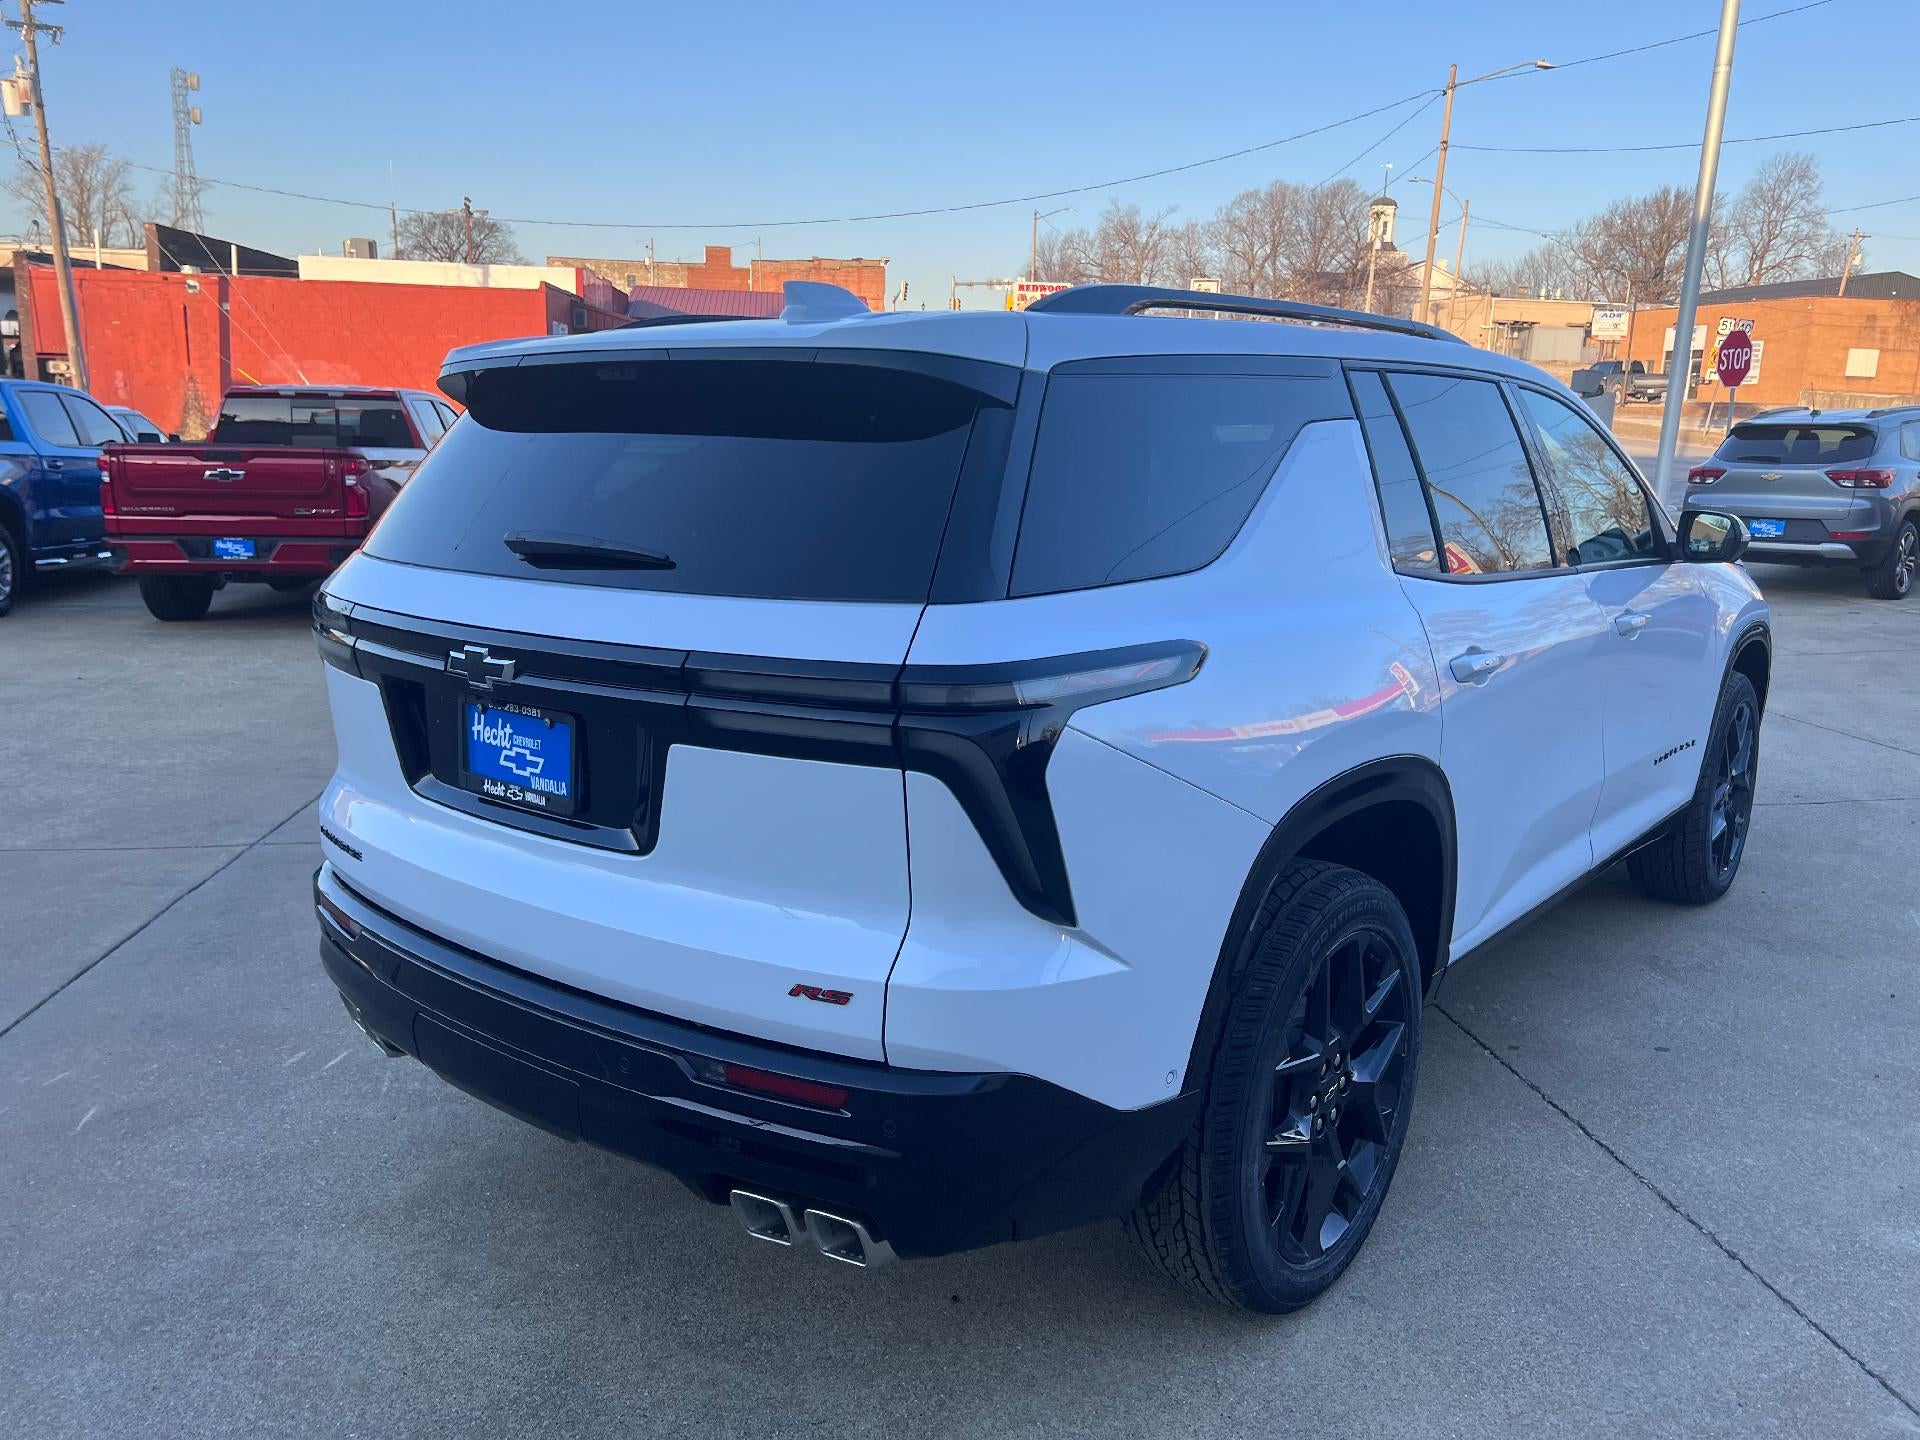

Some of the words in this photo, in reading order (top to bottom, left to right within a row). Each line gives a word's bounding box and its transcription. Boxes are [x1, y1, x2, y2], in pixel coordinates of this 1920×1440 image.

[1719, 347, 1751, 371] STOP
[488, 703, 542, 718] -283-0381
[472, 711, 514, 749] Hecht
[512, 734, 542, 751] CHEVROLET
[483, 778, 506, 797] Hecht
[524, 790, 546, 807] VANDALIA
[530, 775, 567, 797] VANDALIA
[787, 983, 854, 1006] RS
